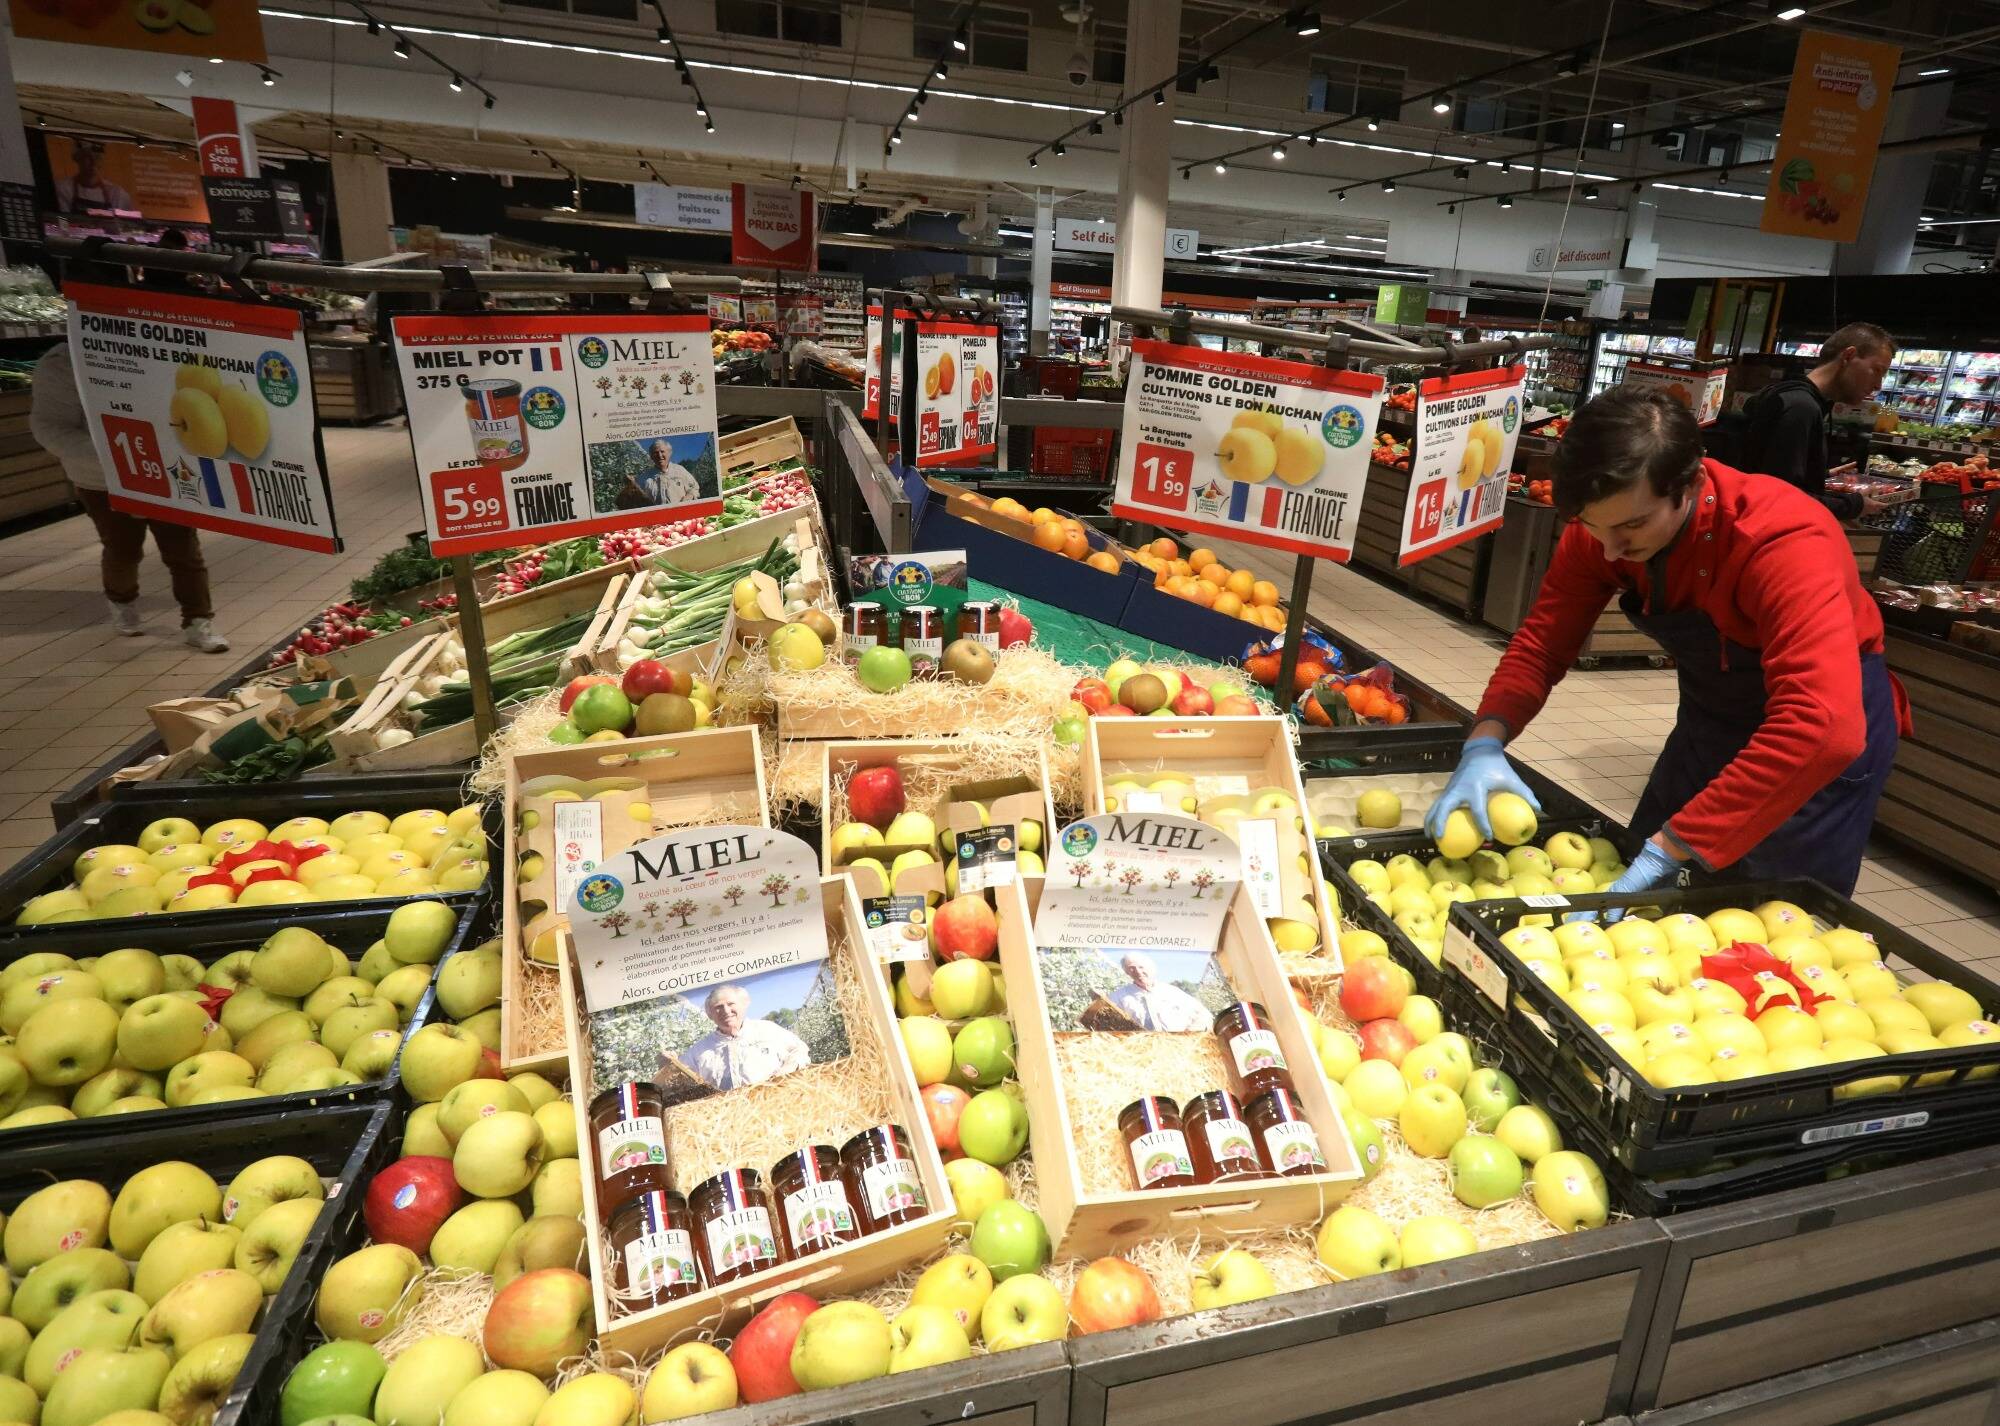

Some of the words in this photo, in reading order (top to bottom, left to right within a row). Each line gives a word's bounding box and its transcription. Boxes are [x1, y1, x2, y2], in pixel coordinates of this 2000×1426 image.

[208, 187, 271, 200] EXOTIQUES
[678, 203, 702, 213] fruits
[748, 219, 774, 231] PRIX
[776, 221, 798, 233] BAS
[1072, 229, 1097, 242] Self
[1073, 286, 1100, 295] Discount
[81, 314, 137, 338] POMME
[140, 323, 208, 348] GOLDEN
[610, 338, 680, 362] MIEL
[962, 338, 987, 347] POMELOS
[82, 337, 150, 358] CULTIVONS
[152, 348, 169, 361] LE
[172, 350, 200, 366] BON
[203, 356, 256, 374] AUCHAN
[412, 350, 472, 369] MIEL
[478, 349, 523, 366] POT
[964, 351, 977, 360] ROSE
[416, 375, 450, 389] 375
[456, 374, 470, 387] G
[1144, 366, 1204, 387] POMME
[1208, 376, 1277, 398] GOLDEN
[122, 402, 133, 413] KG
[1142, 383, 1212, 404] CULTIVONS
[1215, 395, 1232, 407] LE
[1235, 399, 1264, 412] BON
[1266, 404, 1323, 422] AUCHAN
[1426, 400, 1455, 418] POMME
[1457, 395, 1487, 411] GOLDEN
[475, 420, 512, 433] MIEL
[661, 424, 695, 435] COMPAREZ
[964, 421, 971, 439] 0
[1425, 417, 1460, 433] CULTIVONS
[1461, 416, 1468, 425] LE
[1469, 413, 1480, 423] BON
[1481, 408, 1504, 420] AUCHAN
[921, 423, 929, 444] 5
[929, 432, 938, 443] 49
[1152, 426, 1192, 439] Barquette
[1163, 438, 1186, 447] fruits
[114, 431, 138, 476] 1
[141, 459, 162, 480] 99
[448, 461, 460, 469] LE
[463, 459, 481, 468] POT
[272, 459, 305, 473] ORIGINE
[511, 473, 553, 485] ORIGINE
[1142, 456, 1160, 492] 1
[1163, 480, 1184, 497] 99
[249, 466, 319, 527] FRANCE
[1314, 487, 1348, 500] ORIGINE
[444, 487, 469, 521] 5
[472, 497, 500, 518] 99
[514, 482, 577, 527] FRANCE
[1418, 494, 1430, 529] 1
[1427, 510, 1441, 527] 99
[1281, 491, 1347, 541] FRANCE
[845, 634, 868, 645] MIEL
[911, 640, 936, 648] MIEL
[1104, 815, 1205, 850] MIEL
[626, 834, 761, 885] MIEL
[638, 887, 671, 900] Récolté
[672, 885, 684, 894] au
[685, 880, 707, 892] cœur
[708, 875, 719, 887] de
[721, 873, 737, 883] nos
[738, 868, 768, 882] vergers
[1102, 896, 1119, 904] dans
[1136, 898, 1165, 908] vergers,
[623, 945, 670, 964] pollinisation
[671, 942, 684, 953] des
[685, 937, 706, 950] fleurs
[707, 935, 717, 946] de
[718, 930, 752, 945] pommier
[753, 926, 766, 940] par
[766, 923, 778, 933] les
[778, 917, 804, 930] abeilles
[641, 935, 655, 947] Ici,
[658, 931, 681, 944] dans
[683, 928, 701, 940] nos
[703, 919, 739, 937] vergers,
[1059, 933, 1085, 945] Alors,
[1086, 932, 1127, 945] GOÛTEZ
[1128, 936, 1138, 945] et
[1139, 936, 1191, 948] COMPAREZ
[625, 954, 668, 973] production
[668, 950, 679, 962] de
[680, 947, 712, 962] pommes
[626, 965, 671, 982] élaboration
[691, 956, 707, 968] miel
[708, 950, 746, 964] savoureux
[621, 983, 655, 1001] Alors,
[658, 969, 710, 991] GOÛTEZ
[713, 968, 725, 980] et
[727, 951, 793, 977] COMPAREZ
[610, 1119, 653, 1139] MIEL
